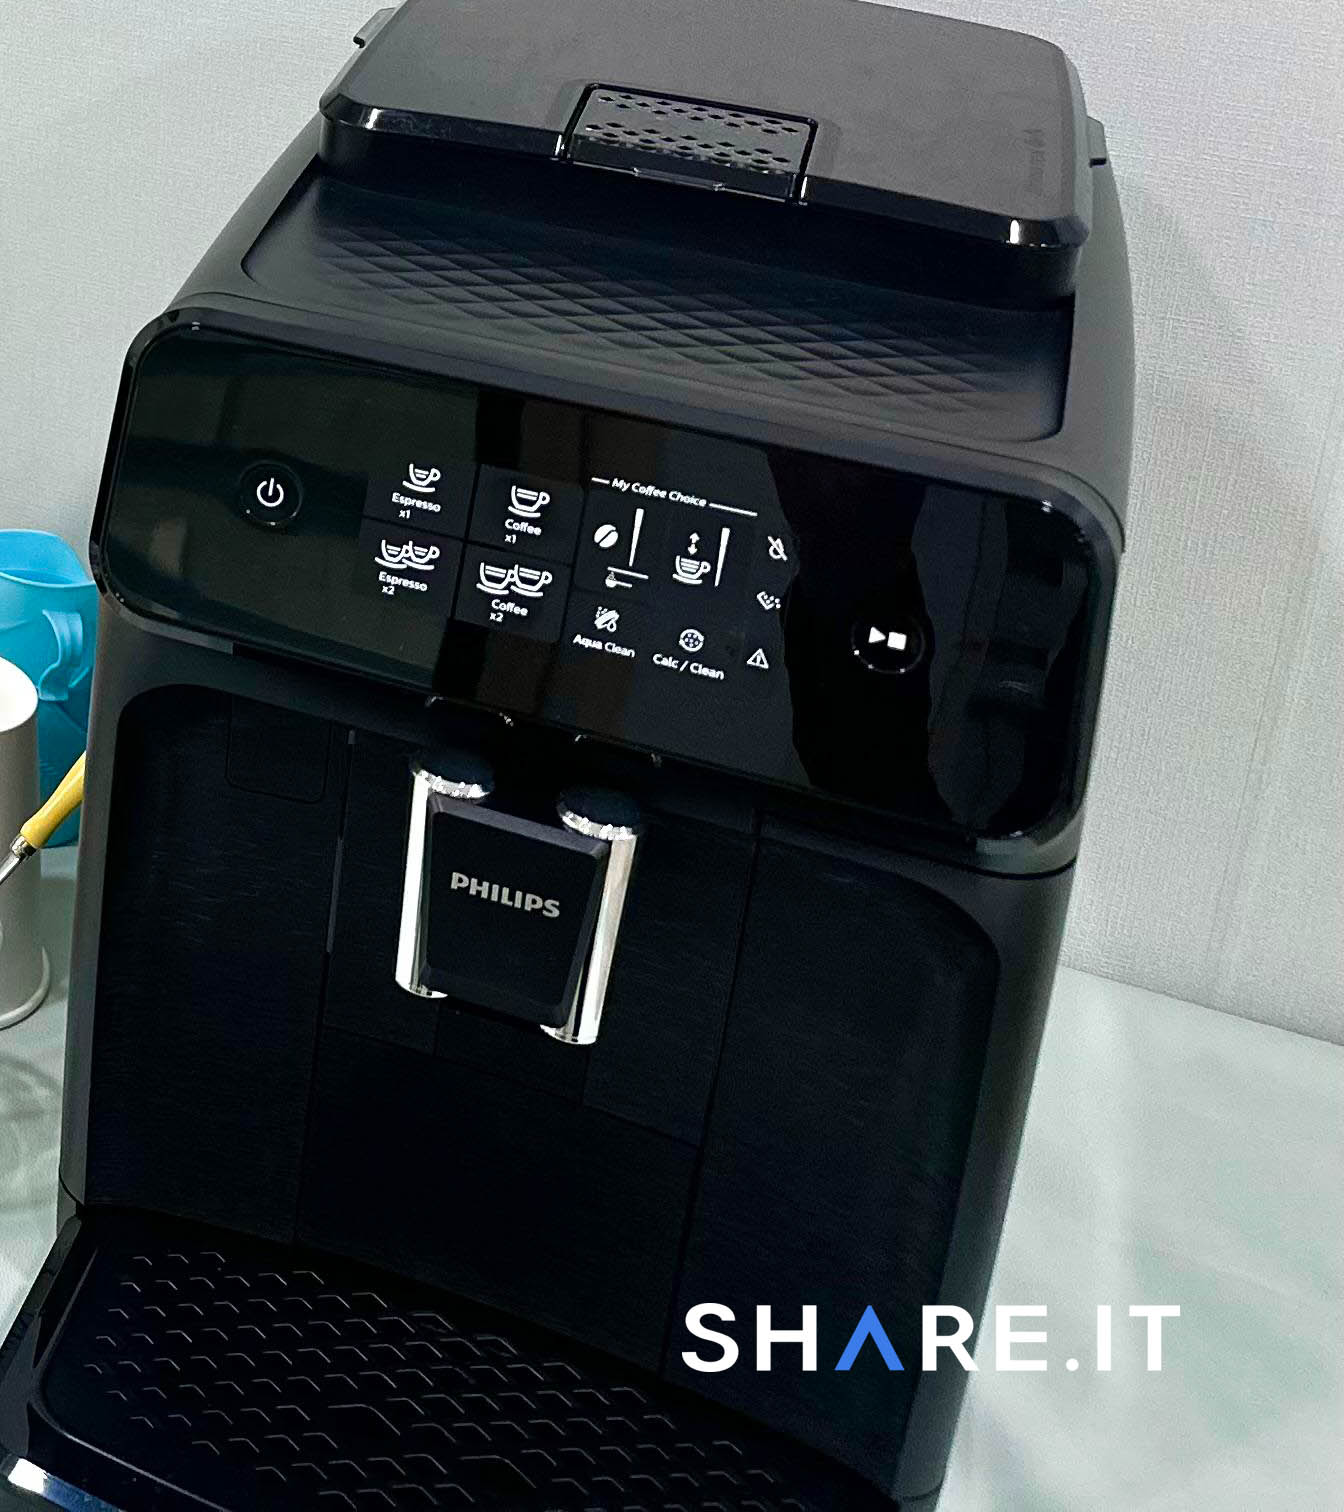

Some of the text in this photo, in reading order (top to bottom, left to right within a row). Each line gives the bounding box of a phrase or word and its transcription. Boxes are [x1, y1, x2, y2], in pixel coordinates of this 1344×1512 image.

[612, 477, 708, 507] My Coffee Choice
[392, 492, 442, 513] Espresso
[398, 509, 411, 519] x1
[504, 518, 542, 536] Coffee
[504, 534, 517, 544] x1
[378, 571, 428, 592] Espresso
[381, 585, 395, 596] x2
[489, 612, 504, 623] x2
[491, 598, 529, 617] Coffee
[573, 634, 636, 658] Aqua Clean
[652, 653, 725, 680] Calc / Clean
[450, 871, 560, 918] PHILIPS
